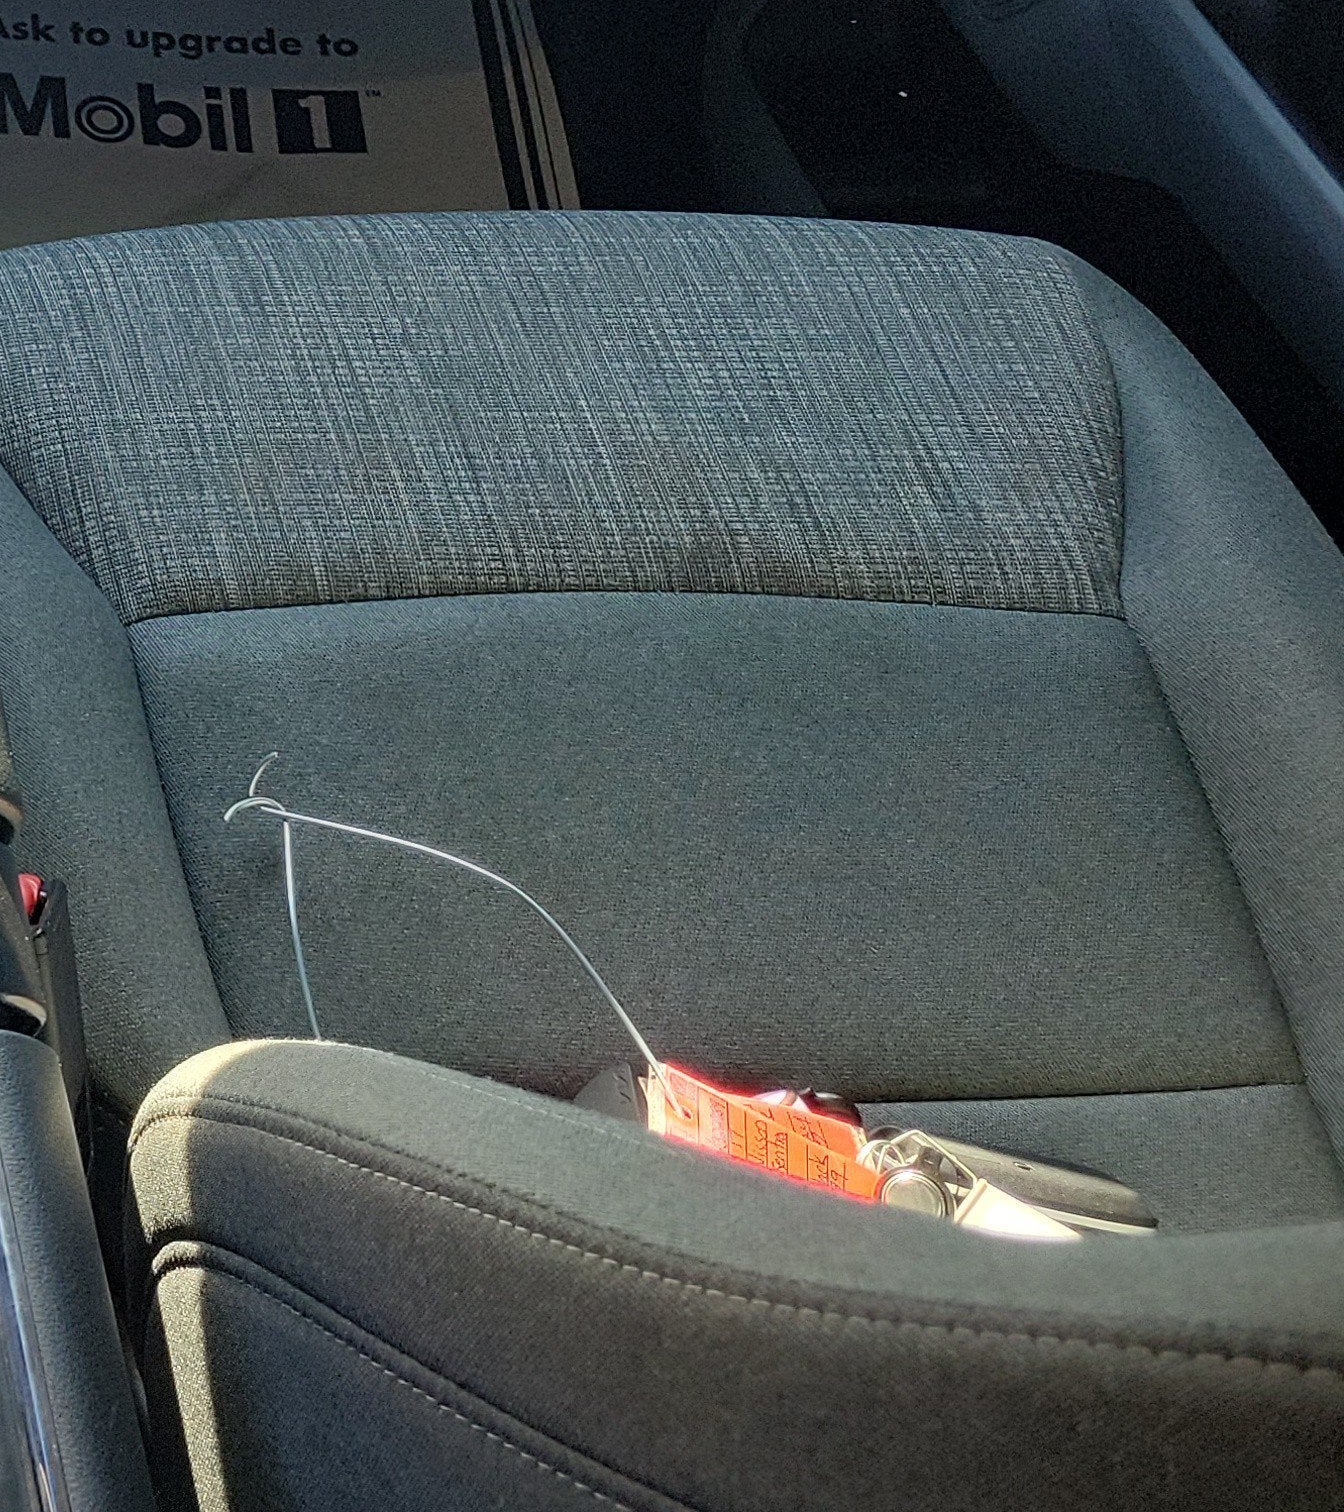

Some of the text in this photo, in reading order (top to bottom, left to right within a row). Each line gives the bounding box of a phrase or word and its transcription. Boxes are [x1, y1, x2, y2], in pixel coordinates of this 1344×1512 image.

[70, 20, 111, 47] to
[124, 26, 303, 60] upgrade
[318, 32, 360, 58] to
